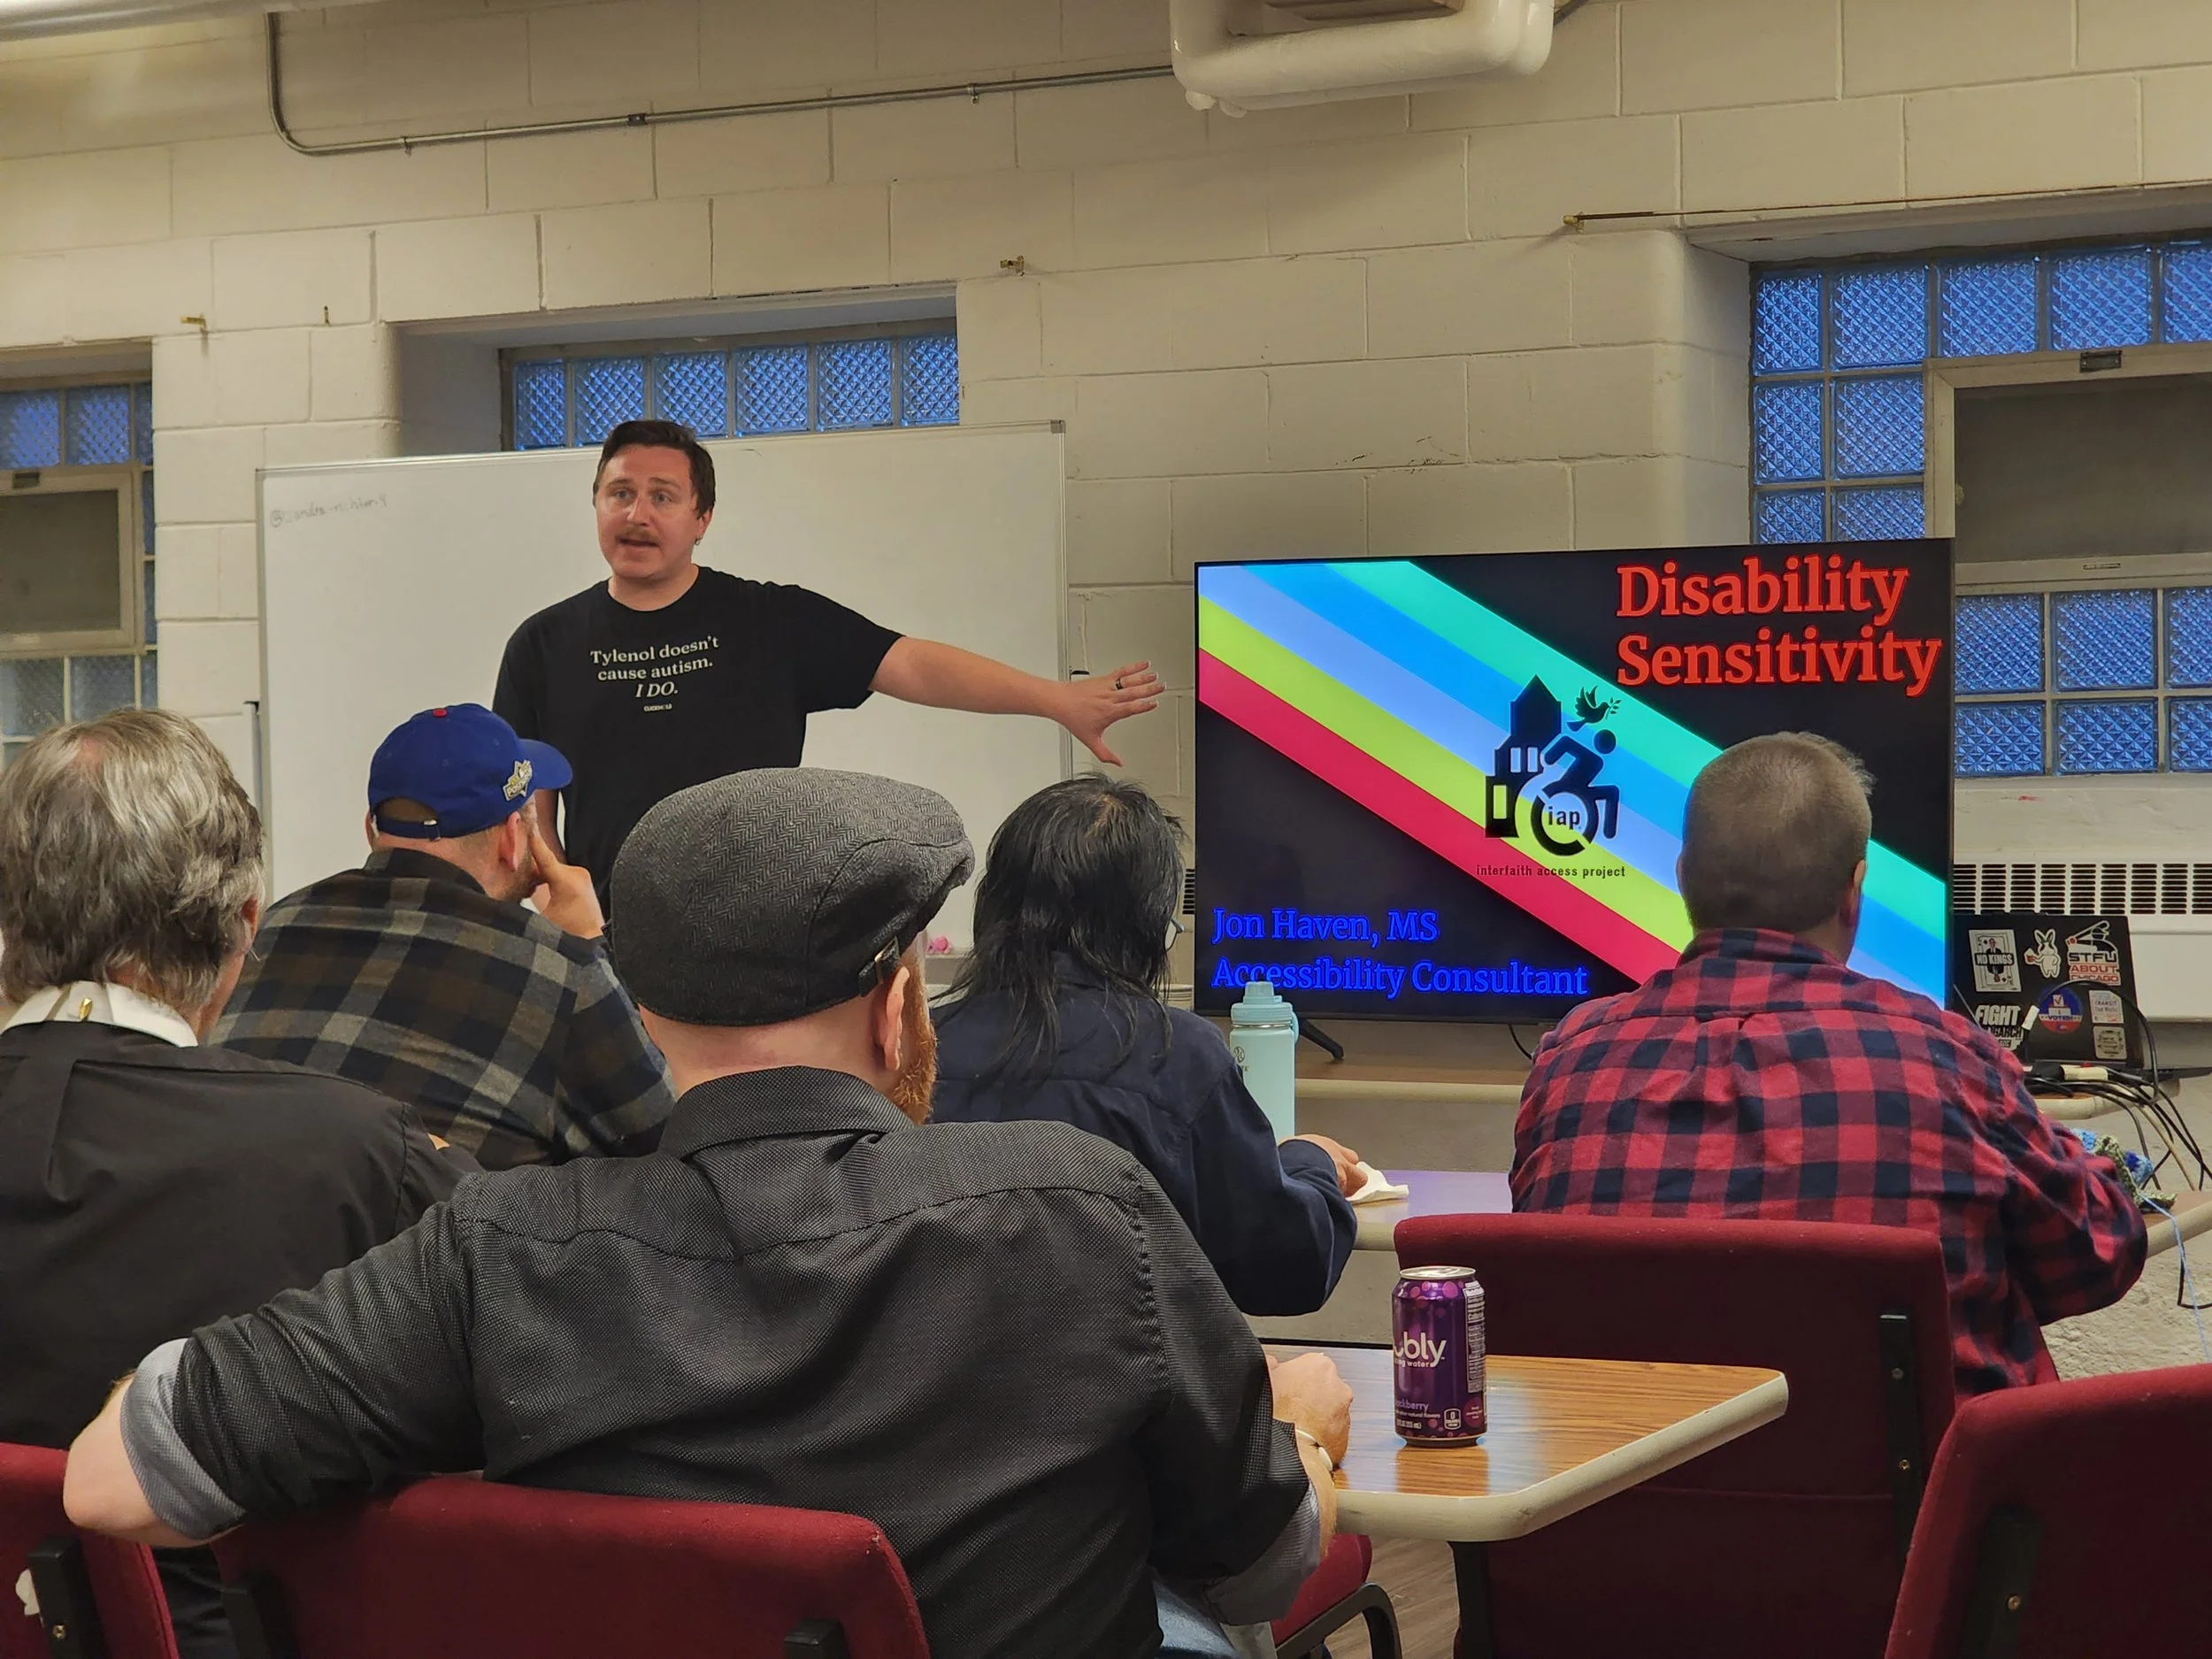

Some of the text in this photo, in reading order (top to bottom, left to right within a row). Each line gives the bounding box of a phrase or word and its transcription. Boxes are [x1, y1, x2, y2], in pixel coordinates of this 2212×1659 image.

[1616, 554, 1910, 626] Disability
[590, 635, 719, 666] Tylenol doesn't
[1617, 625, 1942, 697] Sensitivity
[597, 656, 713, 681] cause autism.
[635, 681, 679, 698] I DO.
[1548, 806, 1581, 830] iap
[1476, 864, 1626, 879] interfaith access project
[1212, 908, 1439, 948] Jon Haven, MS
[1977, 954, 2013, 964] NO KINGS
[2069, 952, 2116, 963] STFU
[2070, 964, 2117, 973] ABOUT
[1211, 956, 1588, 1000] Accessibility Consultant
[1975, 1004, 2022, 1025] FIGHT
